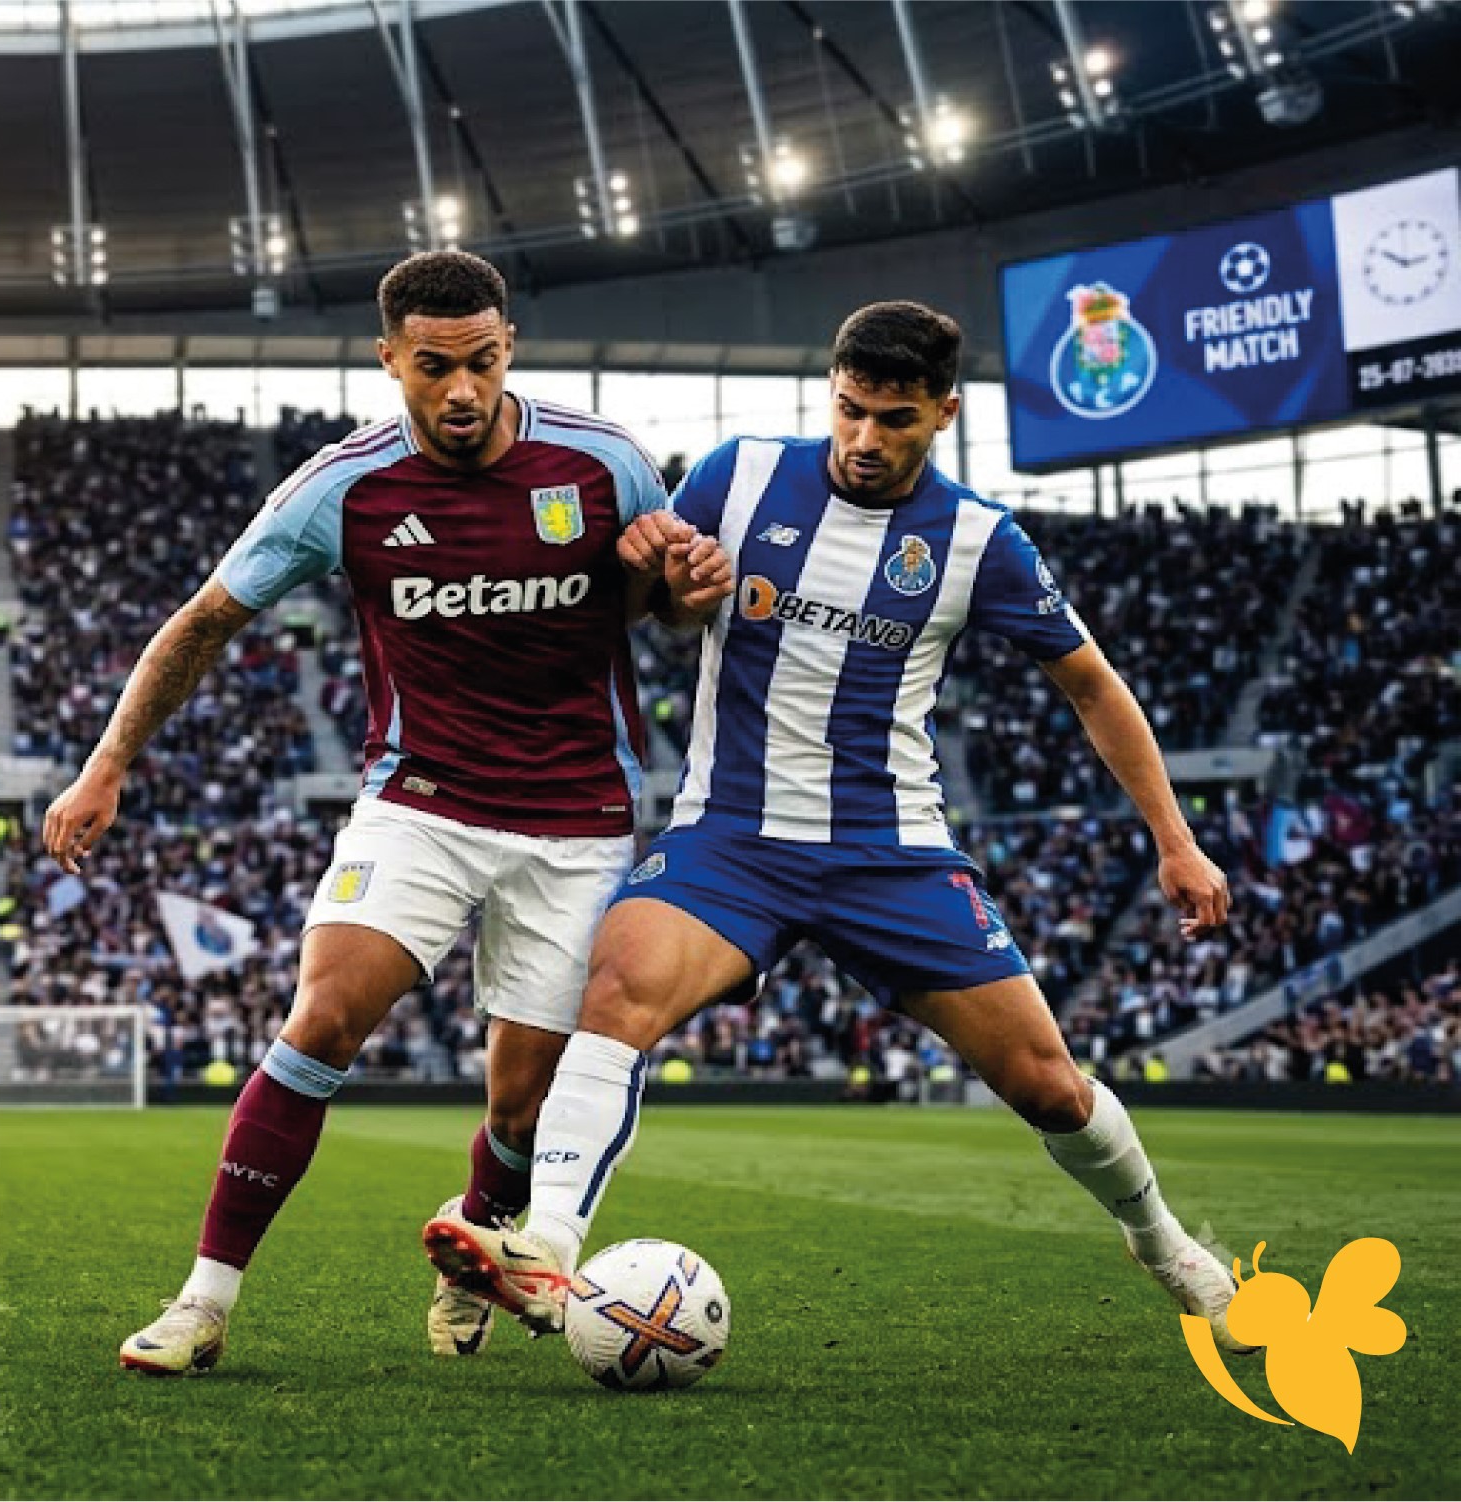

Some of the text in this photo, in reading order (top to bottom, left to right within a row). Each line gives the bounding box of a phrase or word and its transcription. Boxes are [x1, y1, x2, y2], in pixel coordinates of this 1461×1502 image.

[1185, 290, 1313, 341] FRIENDLY
[1203, 327, 1299, 373] MATCH
[389, 573, 590, 621] Betano
[779, 590, 913, 648] BETANO
